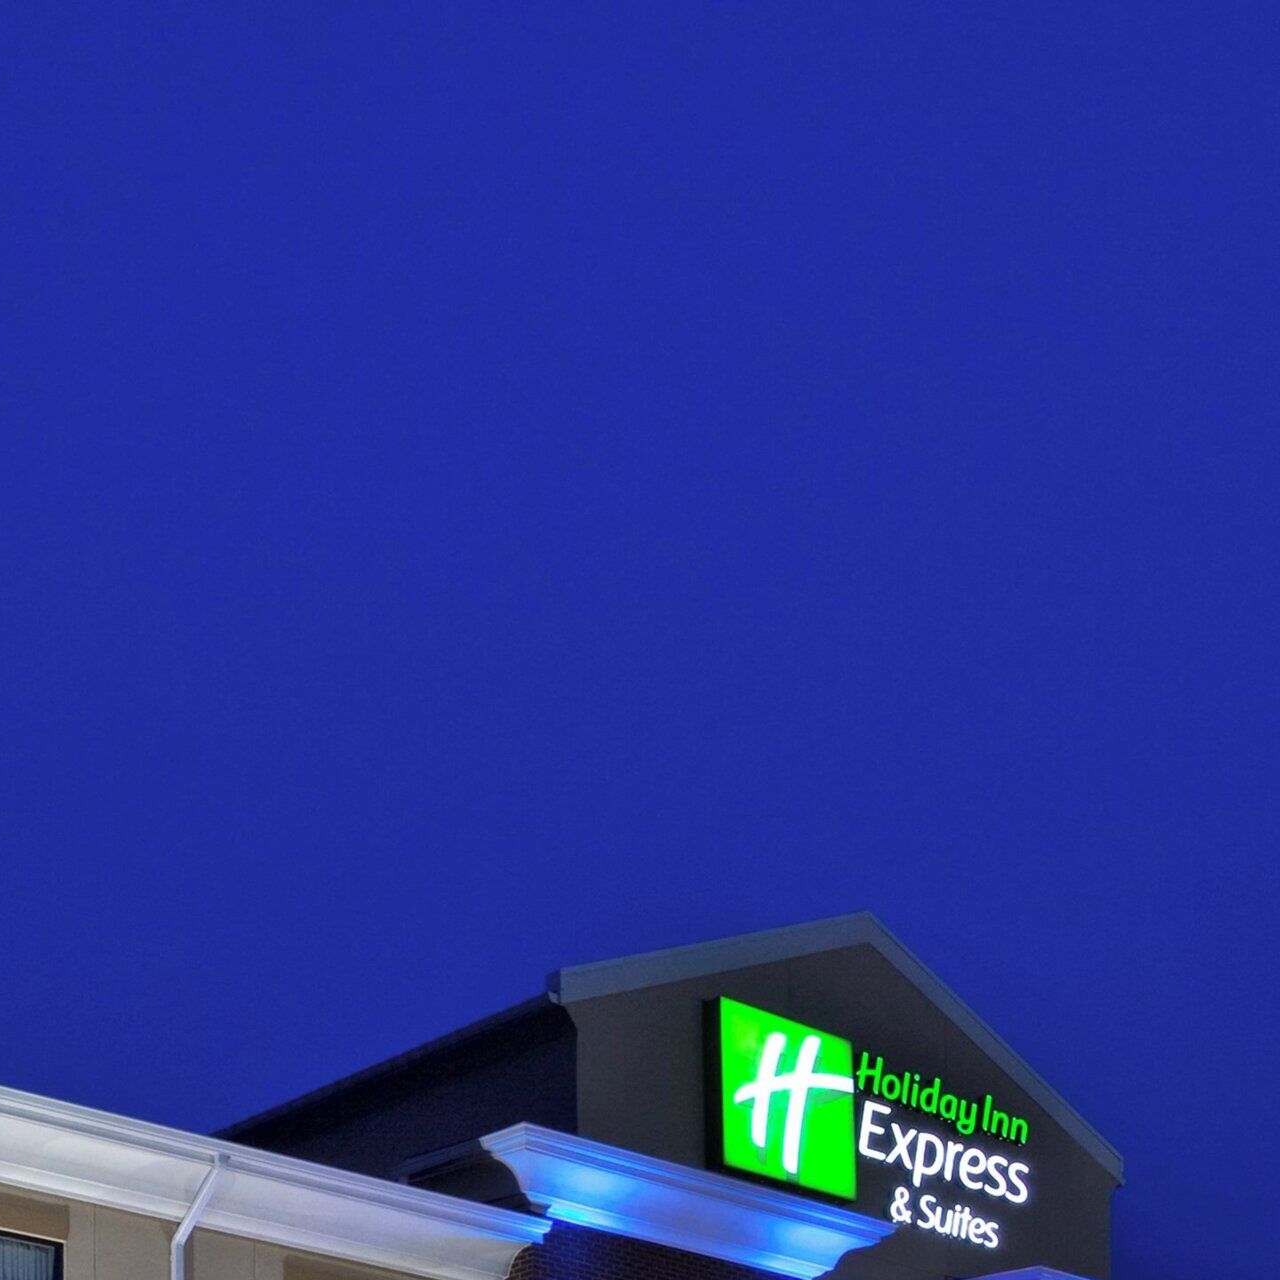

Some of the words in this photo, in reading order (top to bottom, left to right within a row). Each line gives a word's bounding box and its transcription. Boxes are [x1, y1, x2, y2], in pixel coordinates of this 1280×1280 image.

[856, 1052, 977, 1135] Holiday
[982, 1094, 1029, 1145] Inn
[858, 1100, 1030, 1204] Express
[890, 1186, 912, 1223] &
[916, 1194, 1000, 1249] Suites
